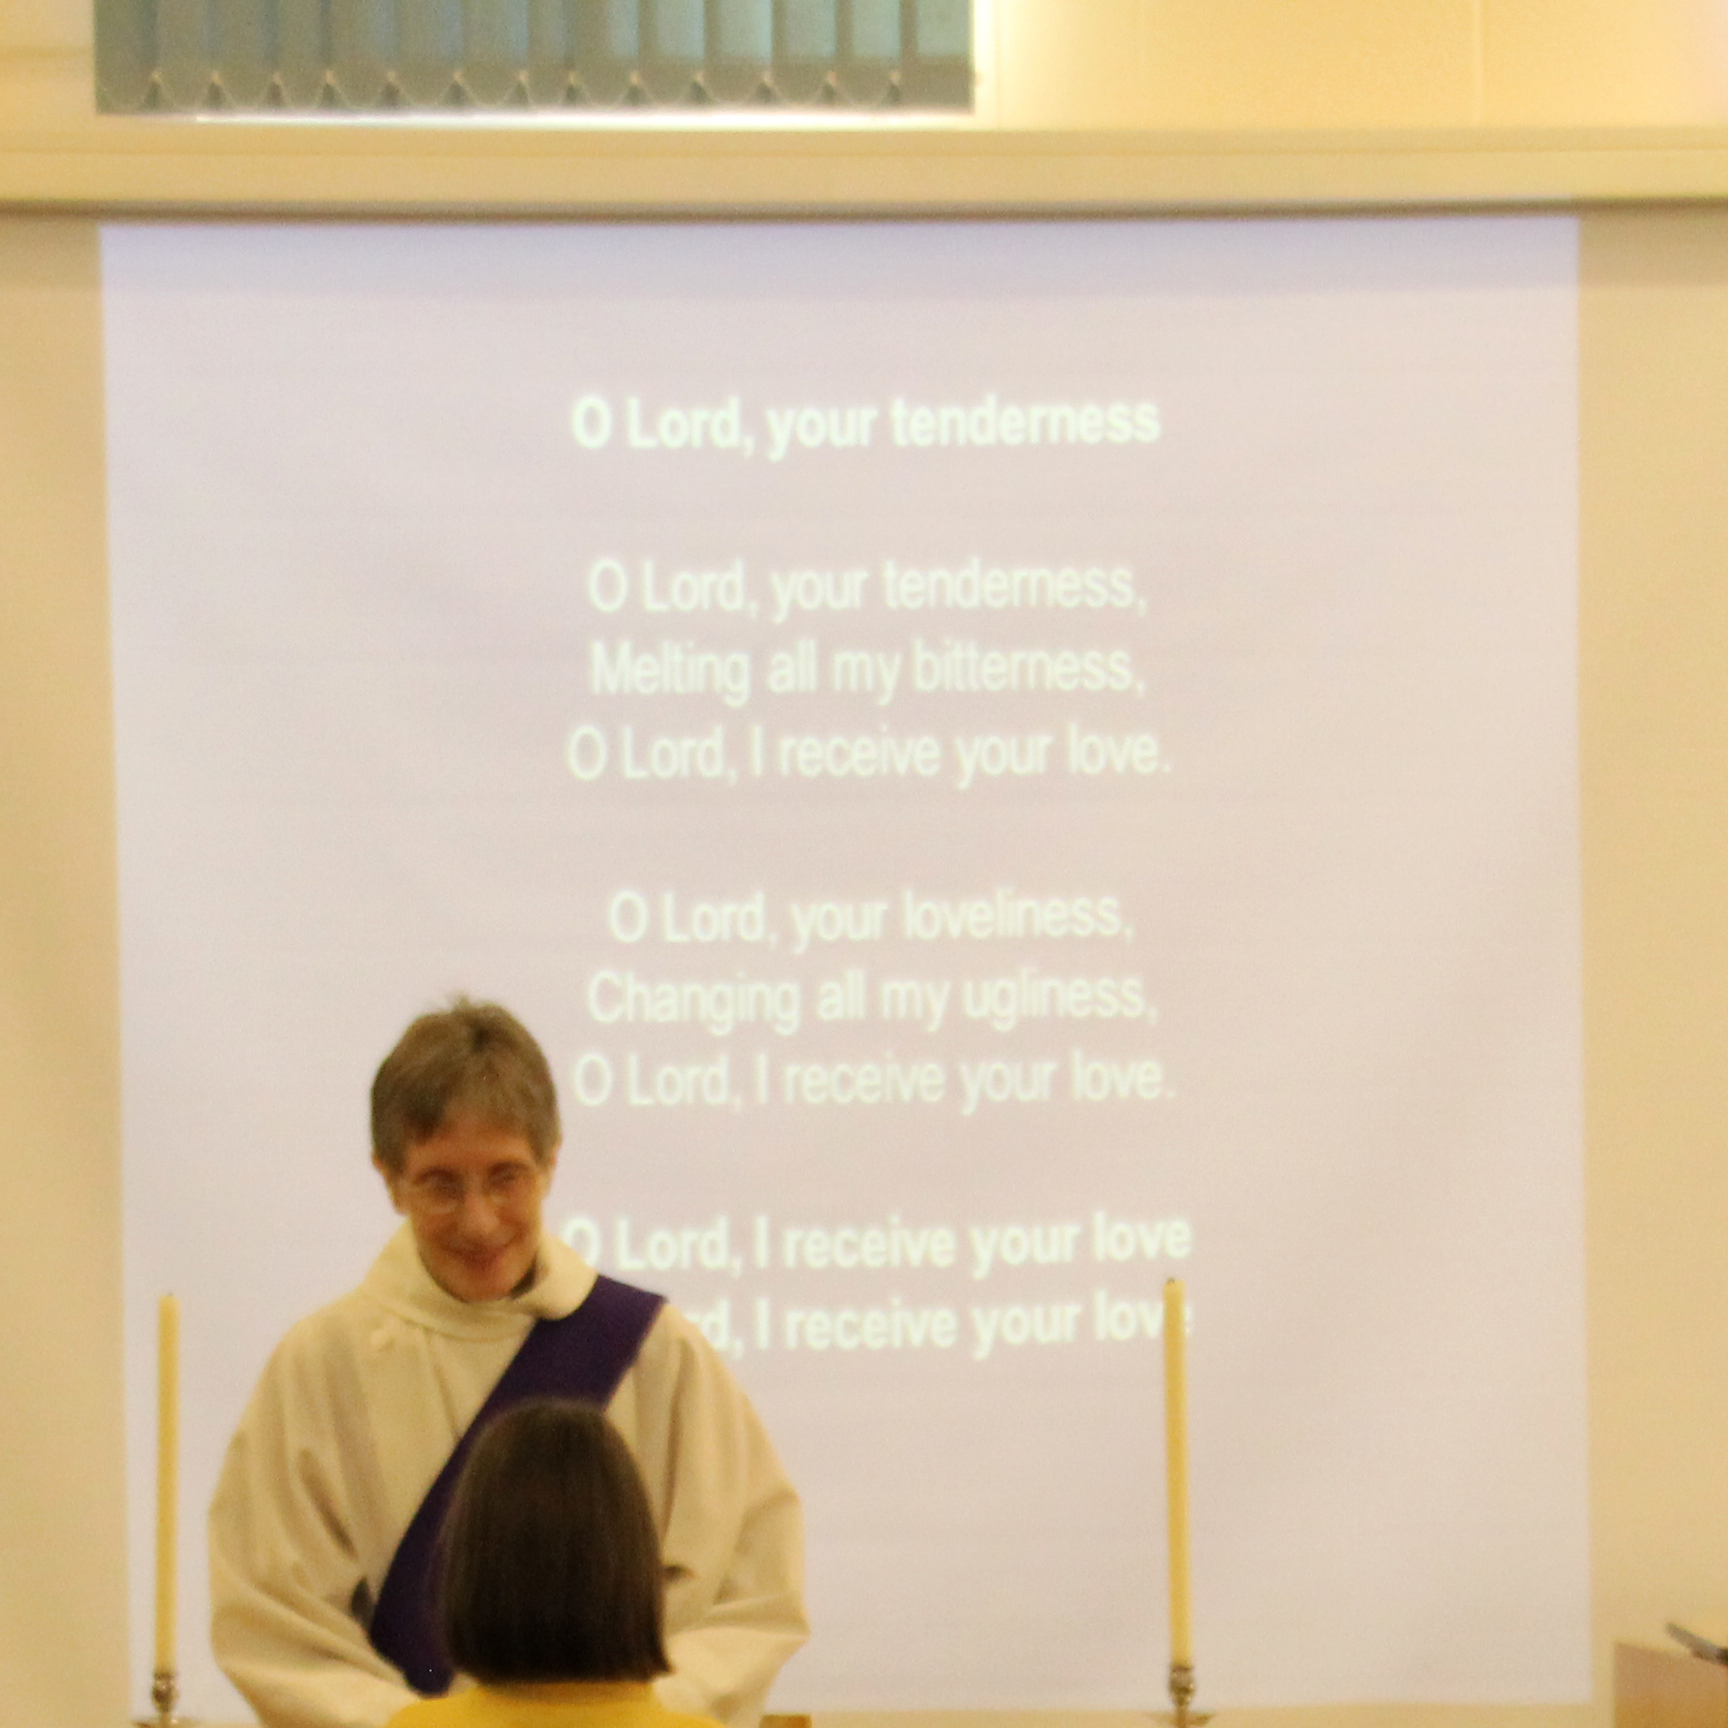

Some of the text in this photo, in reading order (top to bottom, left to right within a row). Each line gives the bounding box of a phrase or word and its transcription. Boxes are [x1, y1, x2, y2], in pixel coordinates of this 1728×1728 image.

[572, 394, 1163, 462] O Lord, your tenderness
[589, 557, 1147, 620] O Lord, your tenderness,
[591, 642, 1146, 705] Melting all my bitterness,
[567, 724, 1169, 789] O Lord, I receive your love.
[607, 887, 1134, 950] O Lord, your loveliness,
[588, 971, 1157, 1033] Changing all my ugliness,
[570, 1050, 1175, 1114] O Lord, I receive your love.
[613, 1214, 739, 1275] Lord,
[755, 1216, 769, 1267] I
[783, 1215, 956, 1267] receive
[970, 1223, 1082, 1277] your
[1092, 1209, 1195, 1260] love
[754, 1300, 770, 1351] I
[784, 1301, 959, 1351] receive
[972, 1304, 1080, 1359] your
[1094, 1291, 1193, 1342] lov
